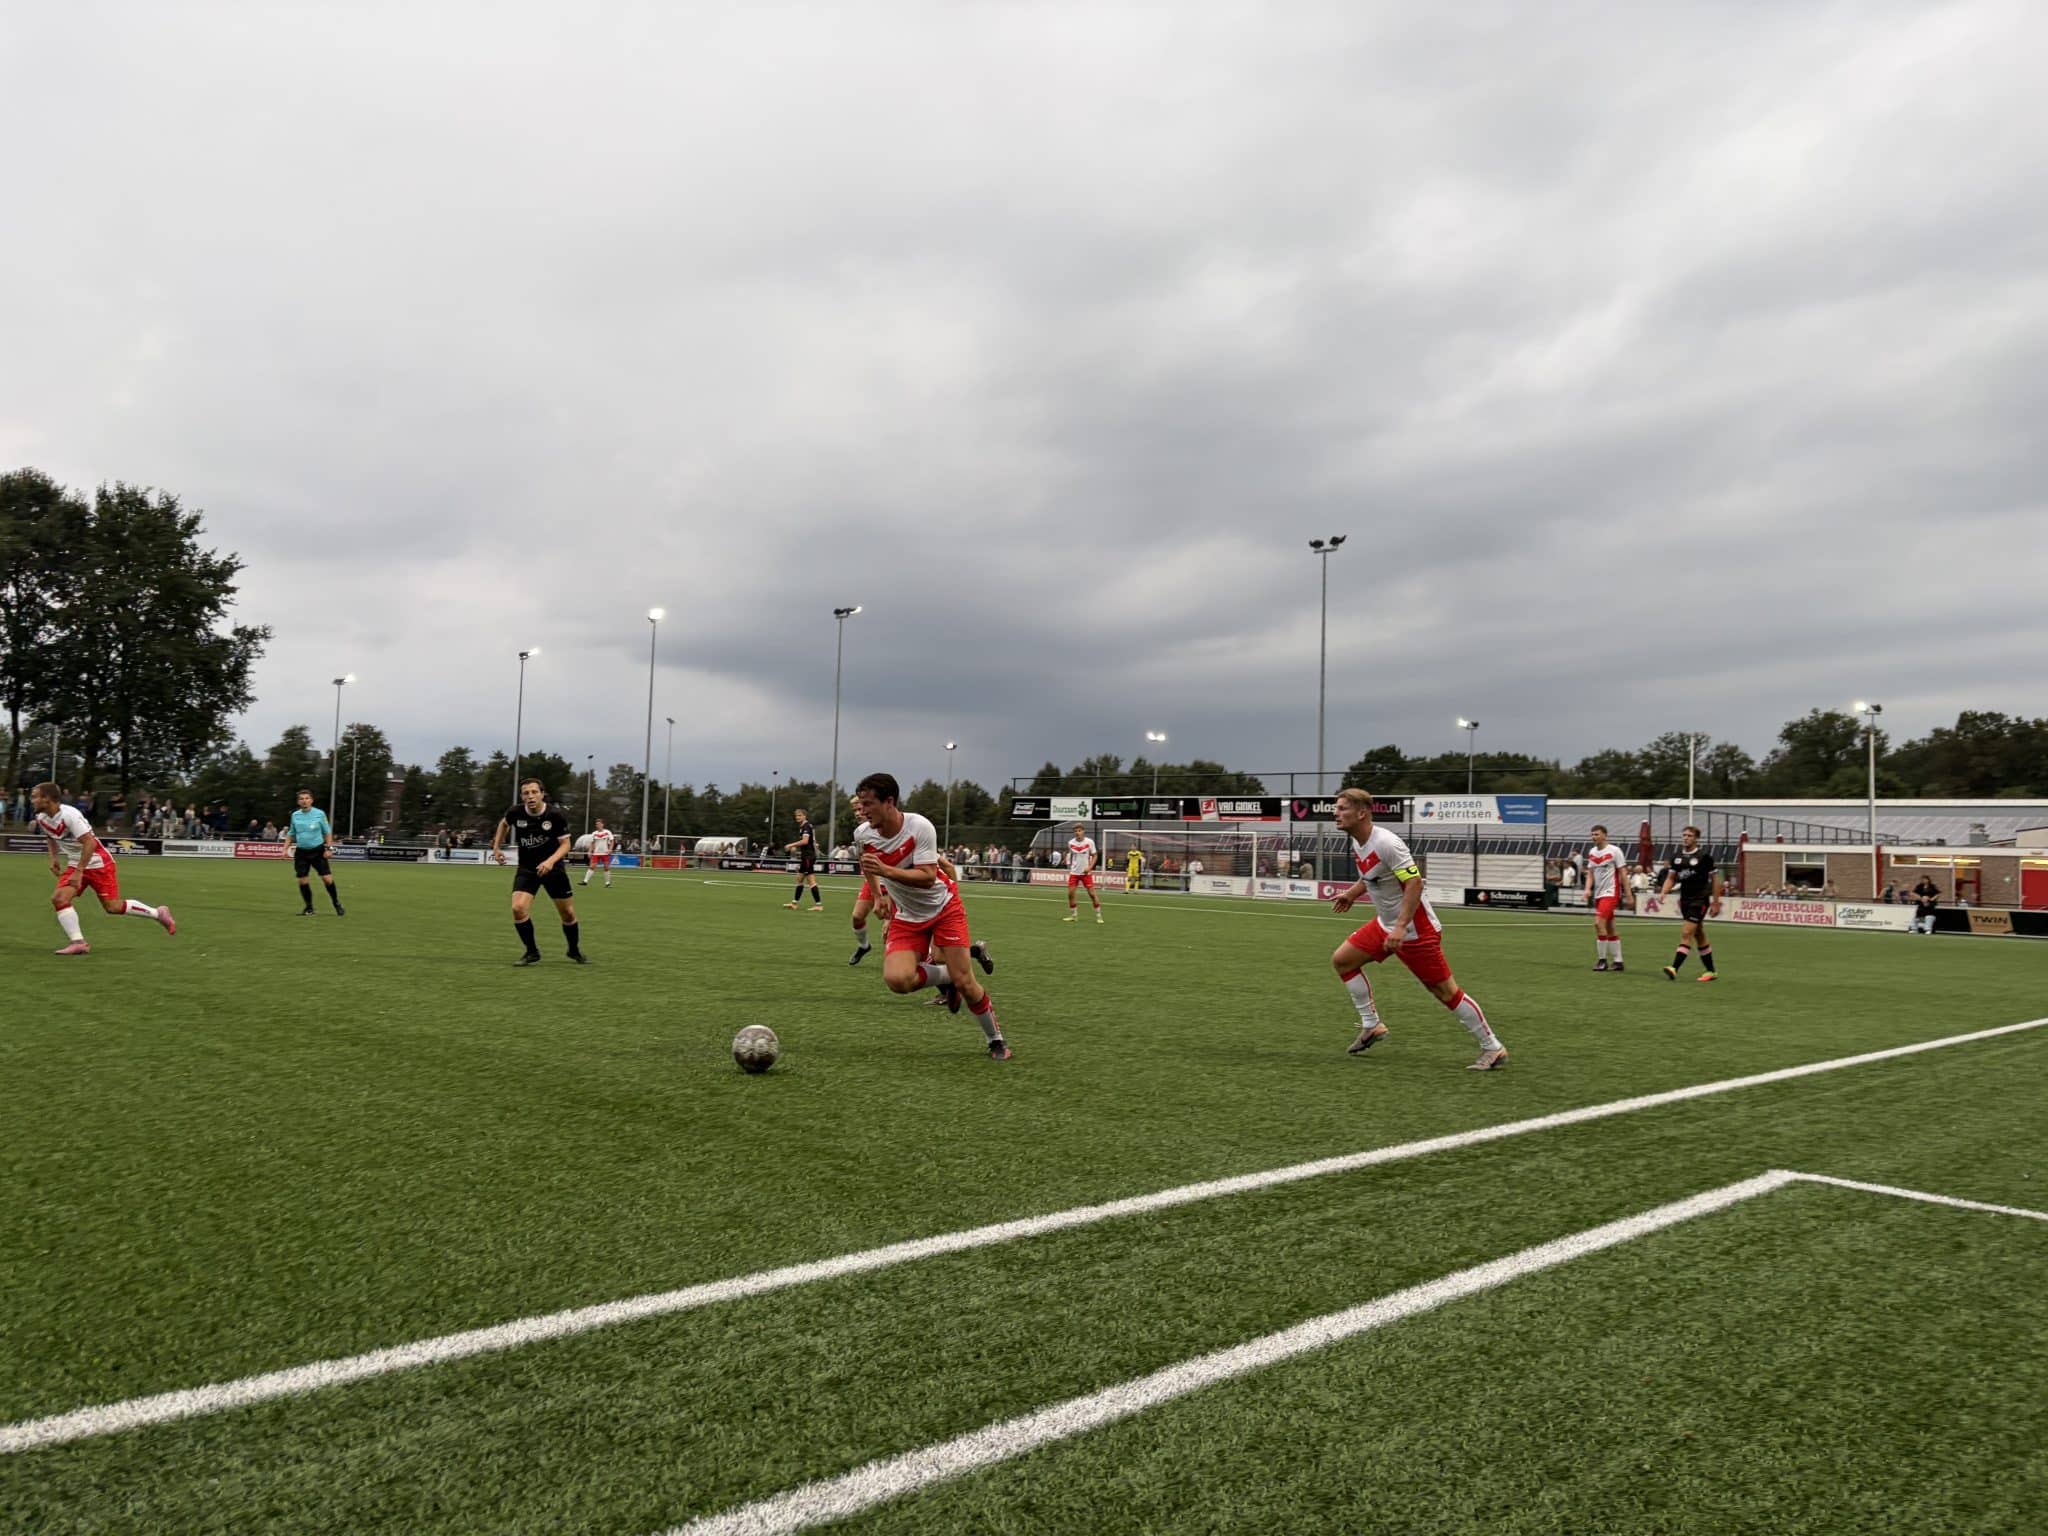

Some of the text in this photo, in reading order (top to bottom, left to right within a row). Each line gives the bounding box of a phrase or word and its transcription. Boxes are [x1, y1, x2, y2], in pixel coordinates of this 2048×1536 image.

[1439, 800, 1482, 809] janssen
[1437, 809, 1492, 820] gerritsen
[1741, 900, 1825, 913] SUPPORTERSCLUB
[1733, 911, 1754, 920] ALLE
[1756, 912, 1792, 923] VOGELS
[1794, 913, 1833, 925] VLIEGEN
[1972, 915, 2008, 925] TWIN
